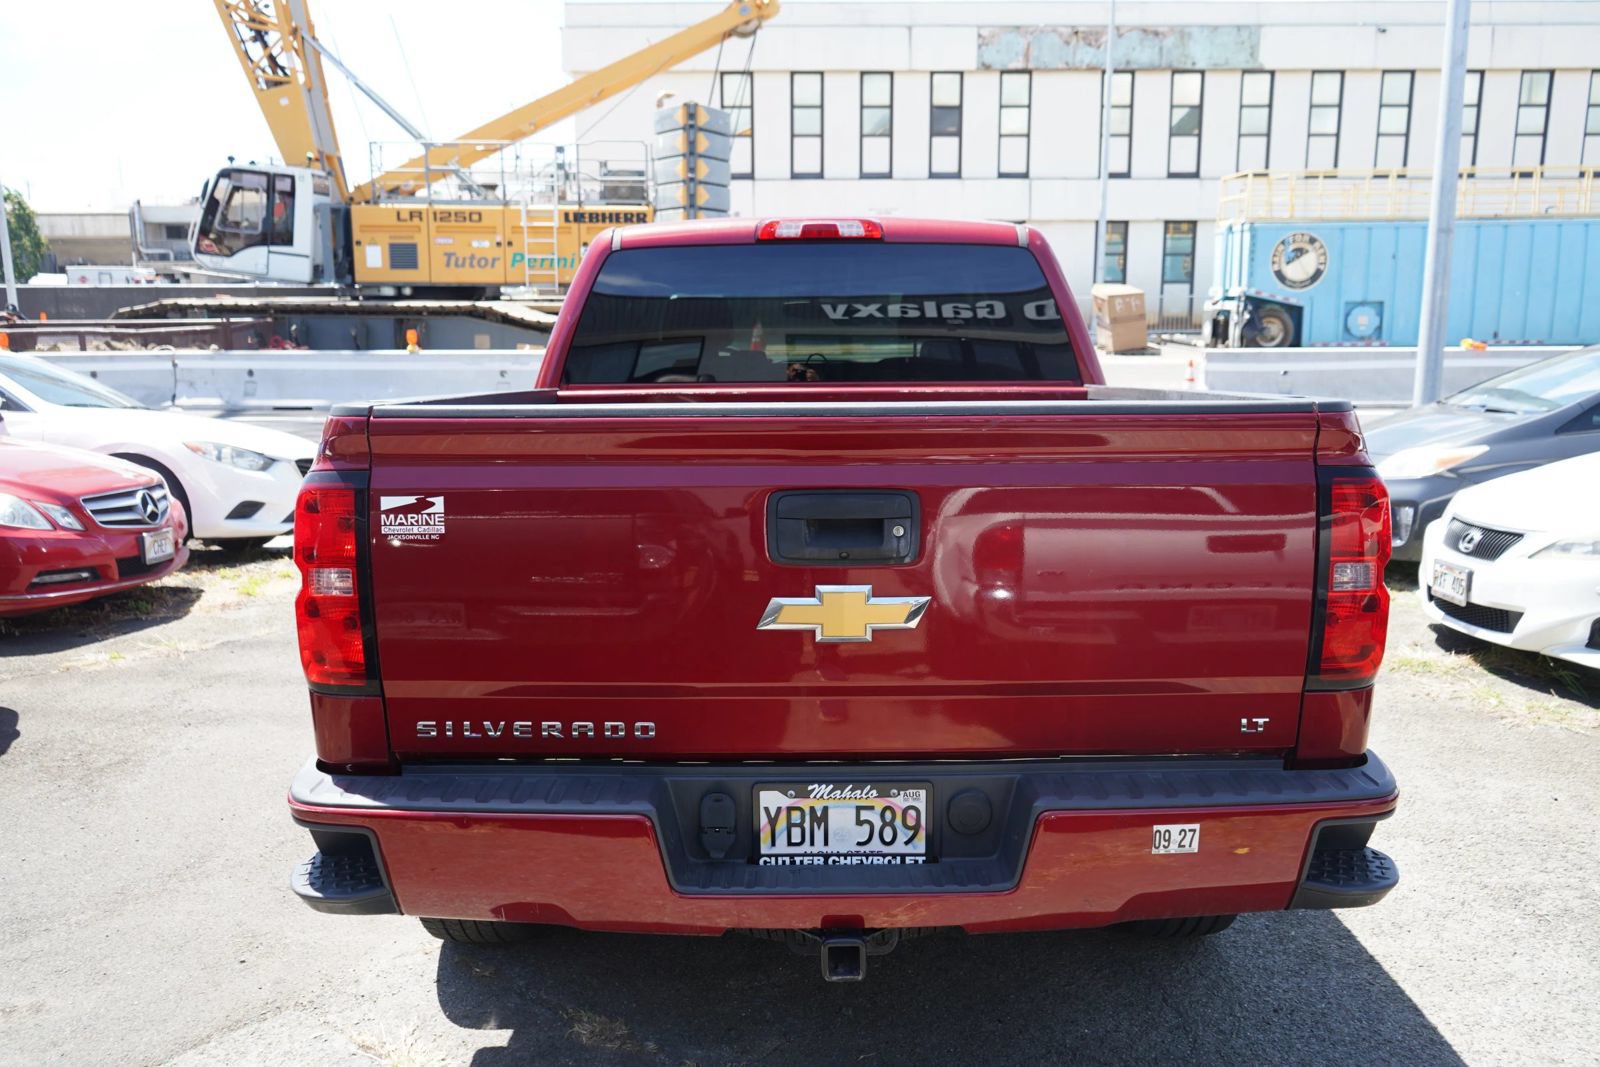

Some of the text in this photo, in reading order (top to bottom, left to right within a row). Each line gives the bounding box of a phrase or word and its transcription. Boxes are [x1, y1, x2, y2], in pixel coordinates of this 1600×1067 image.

[396, 211, 483, 223] LR 1250
[564, 211, 648, 224] LIEBHERR
[443, 252, 501, 269] Tutor
[381, 513, 445, 526] MARINE
[416, 720, 656, 738] SILVERADO
[1240, 717, 1270, 733] LT
[807, 784, 879, 800] Mahalo
[903, 790, 921, 798] AUG
[763, 805, 922, 847] YBM 589
[1153, 828, 1197, 849] 09 27
